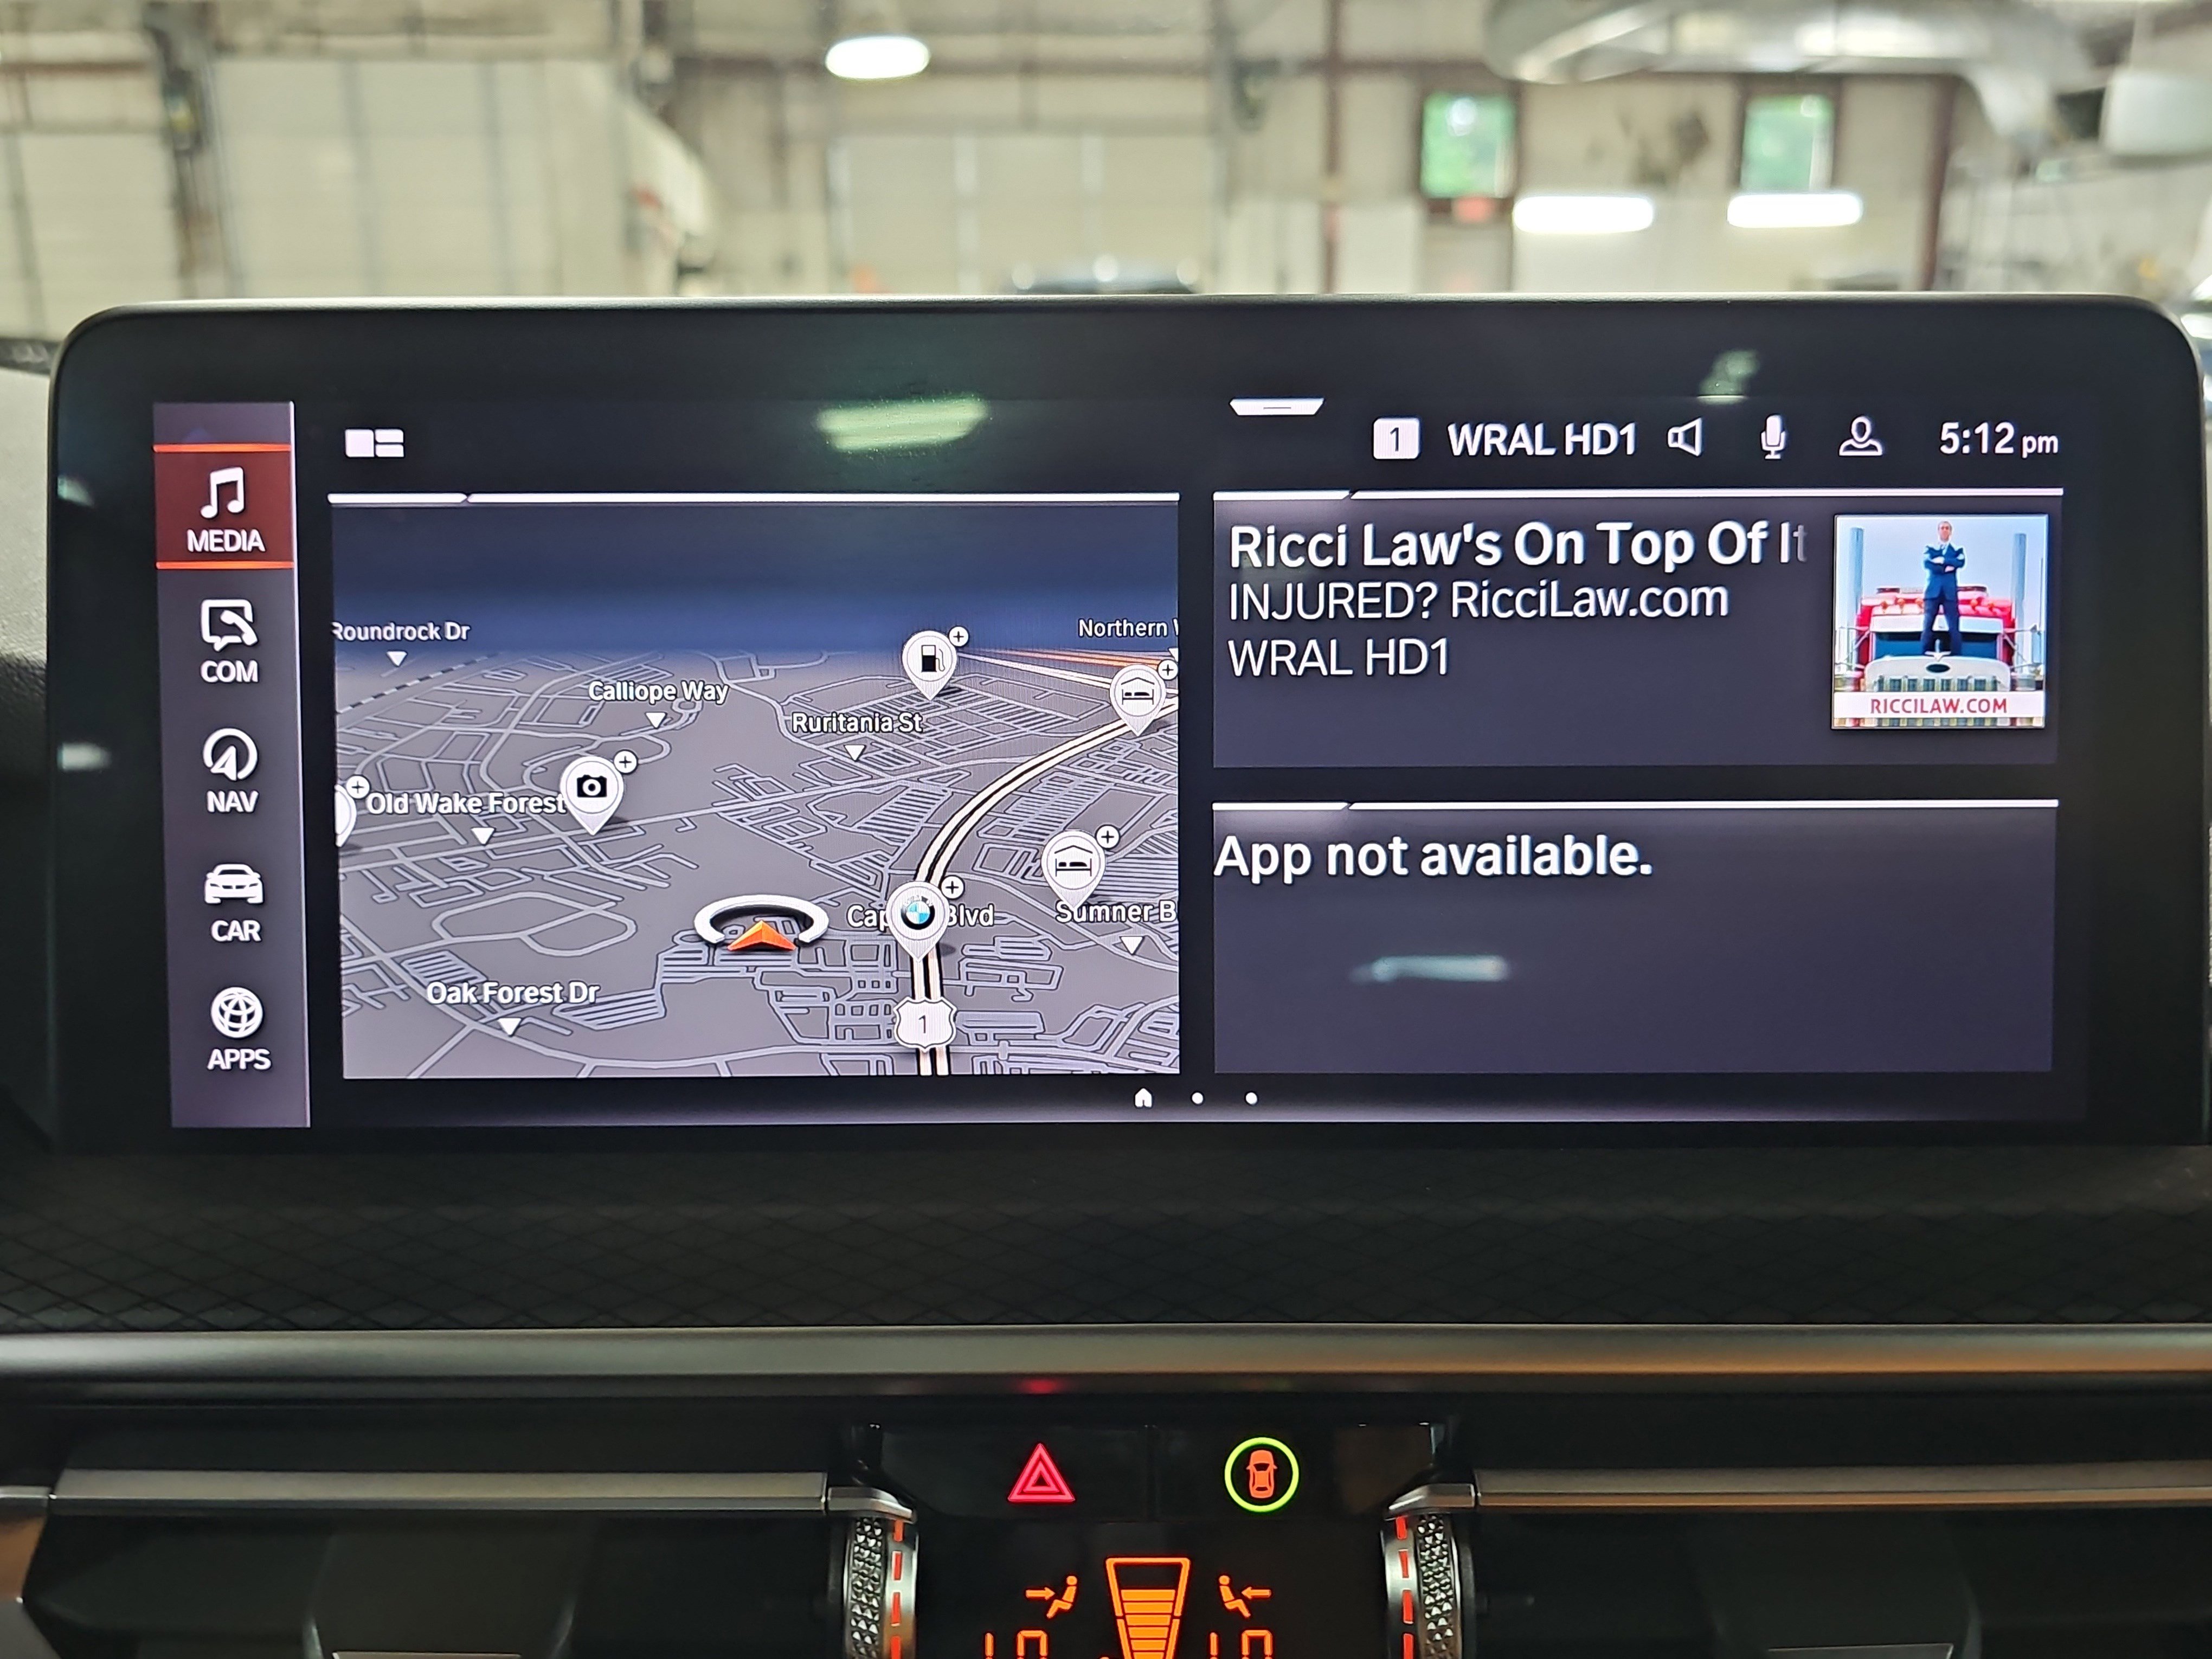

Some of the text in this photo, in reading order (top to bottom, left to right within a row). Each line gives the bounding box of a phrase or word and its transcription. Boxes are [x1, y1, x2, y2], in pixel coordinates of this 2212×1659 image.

[1390, 427, 1400, 452] 1
[1448, 422, 1636, 456] WRAL HD1
[1940, 422, 2059, 459] 5:12 pm
[187, 529, 266, 552] MEDIA
[1231, 524, 1348, 568] Ricci
[1363, 522, 1502, 567] Law's
[1514, 521, 1585, 565] On
[1596, 521, 1695, 573] Top
[1708, 520, 1769, 565] Of
[1230, 580, 1729, 621] INJURED? RicciLaw.com
[331, 621, 471, 641] Roundrock Dr
[1079, 619, 1168, 637] Northern
[1228, 638, 1448, 677] WRAL HD1
[201, 660, 259, 683] COM
[589, 681, 728, 704] Calliope Way
[1870, 698, 2007, 714] RICCILAW.COM
[793, 712, 923, 733] Ruritania St
[207, 791, 259, 813] NAV
[367, 793, 565, 814] Old Wake Forest
[1214, 834, 1652, 884] App not available.
[1056, 901, 1154, 922] Sumner
[211, 920, 261, 942] CAR
[427, 982, 600, 1004] Oak Forest Dr
[918, 1014, 926, 1034] 1
[208, 1049, 271, 1070] APPS
